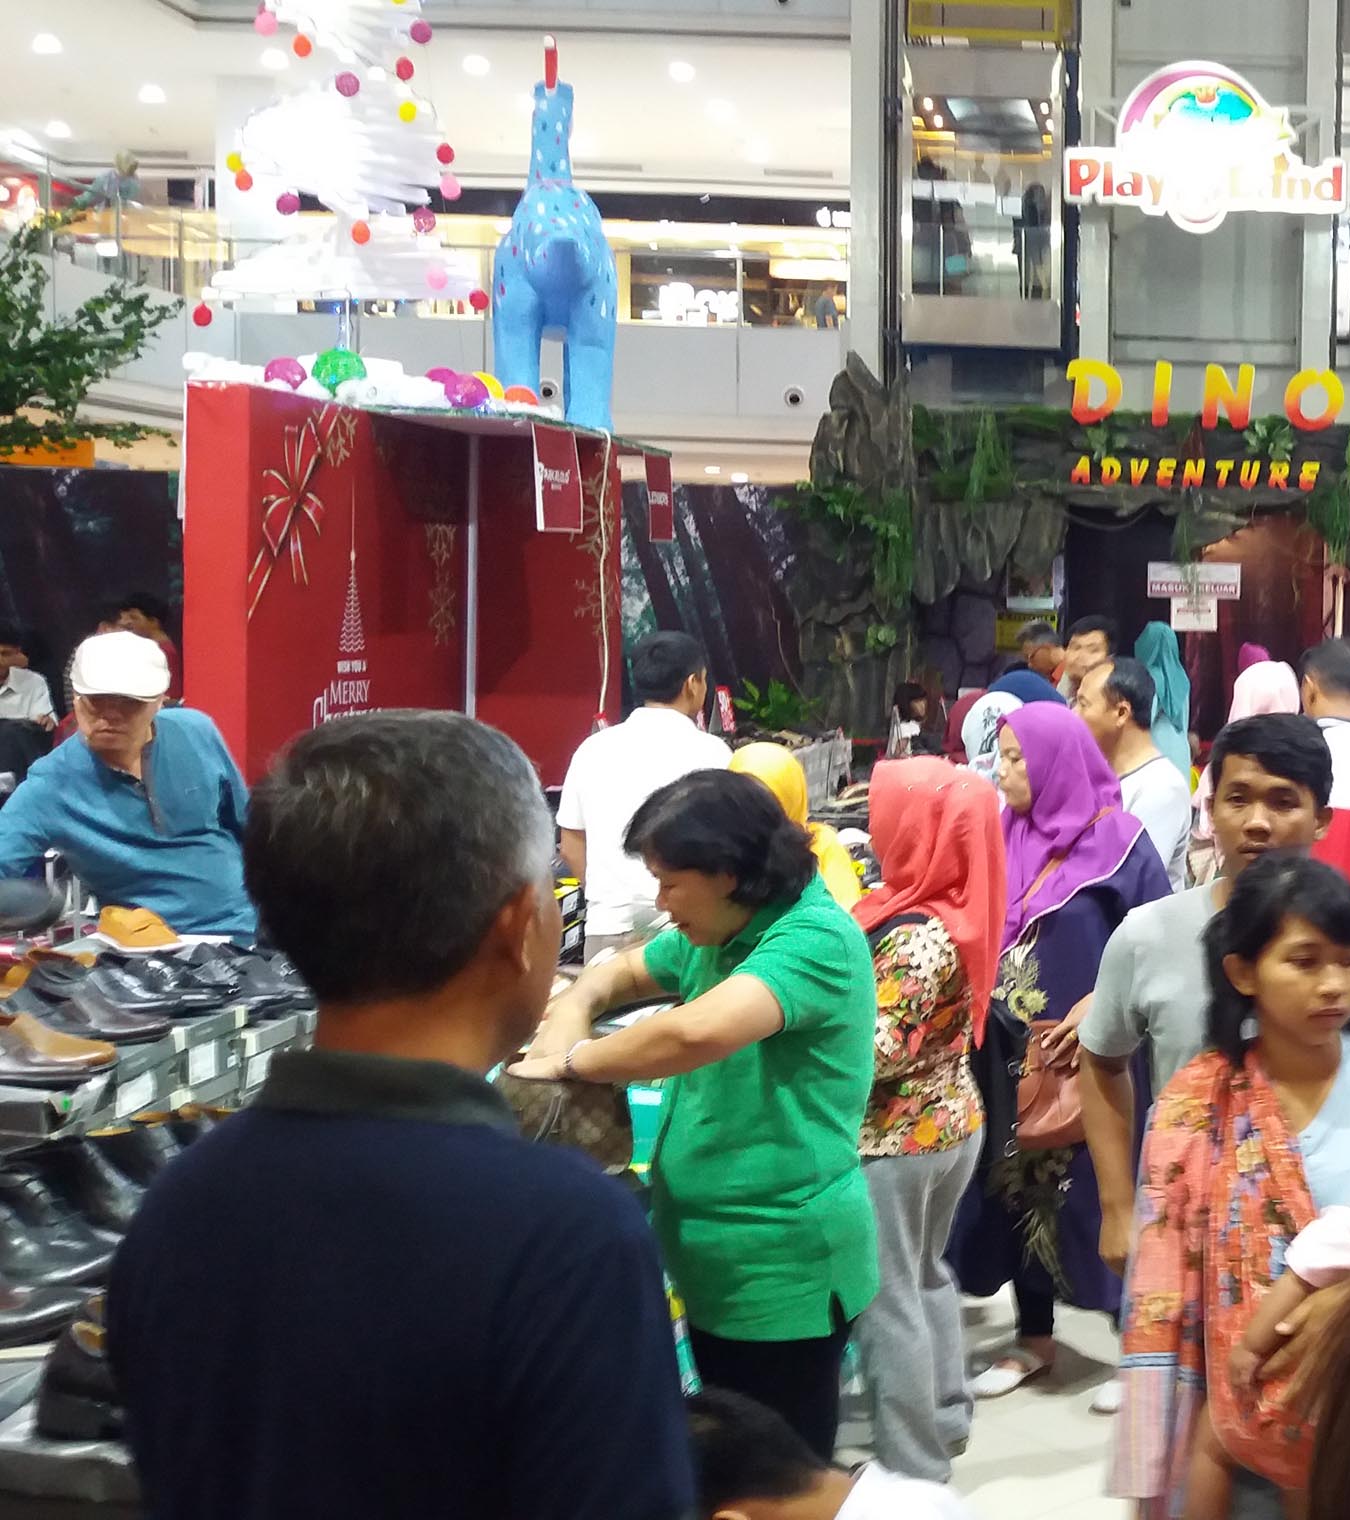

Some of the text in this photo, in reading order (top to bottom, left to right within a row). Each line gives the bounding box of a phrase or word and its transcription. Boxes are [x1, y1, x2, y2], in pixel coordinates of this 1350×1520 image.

[1069, 158, 1165, 206] Play
[1066, 358, 1344, 431] DINO
[1071, 455, 1320, 492] ADVENTURE
[330, 680, 370, 705] MERRY
